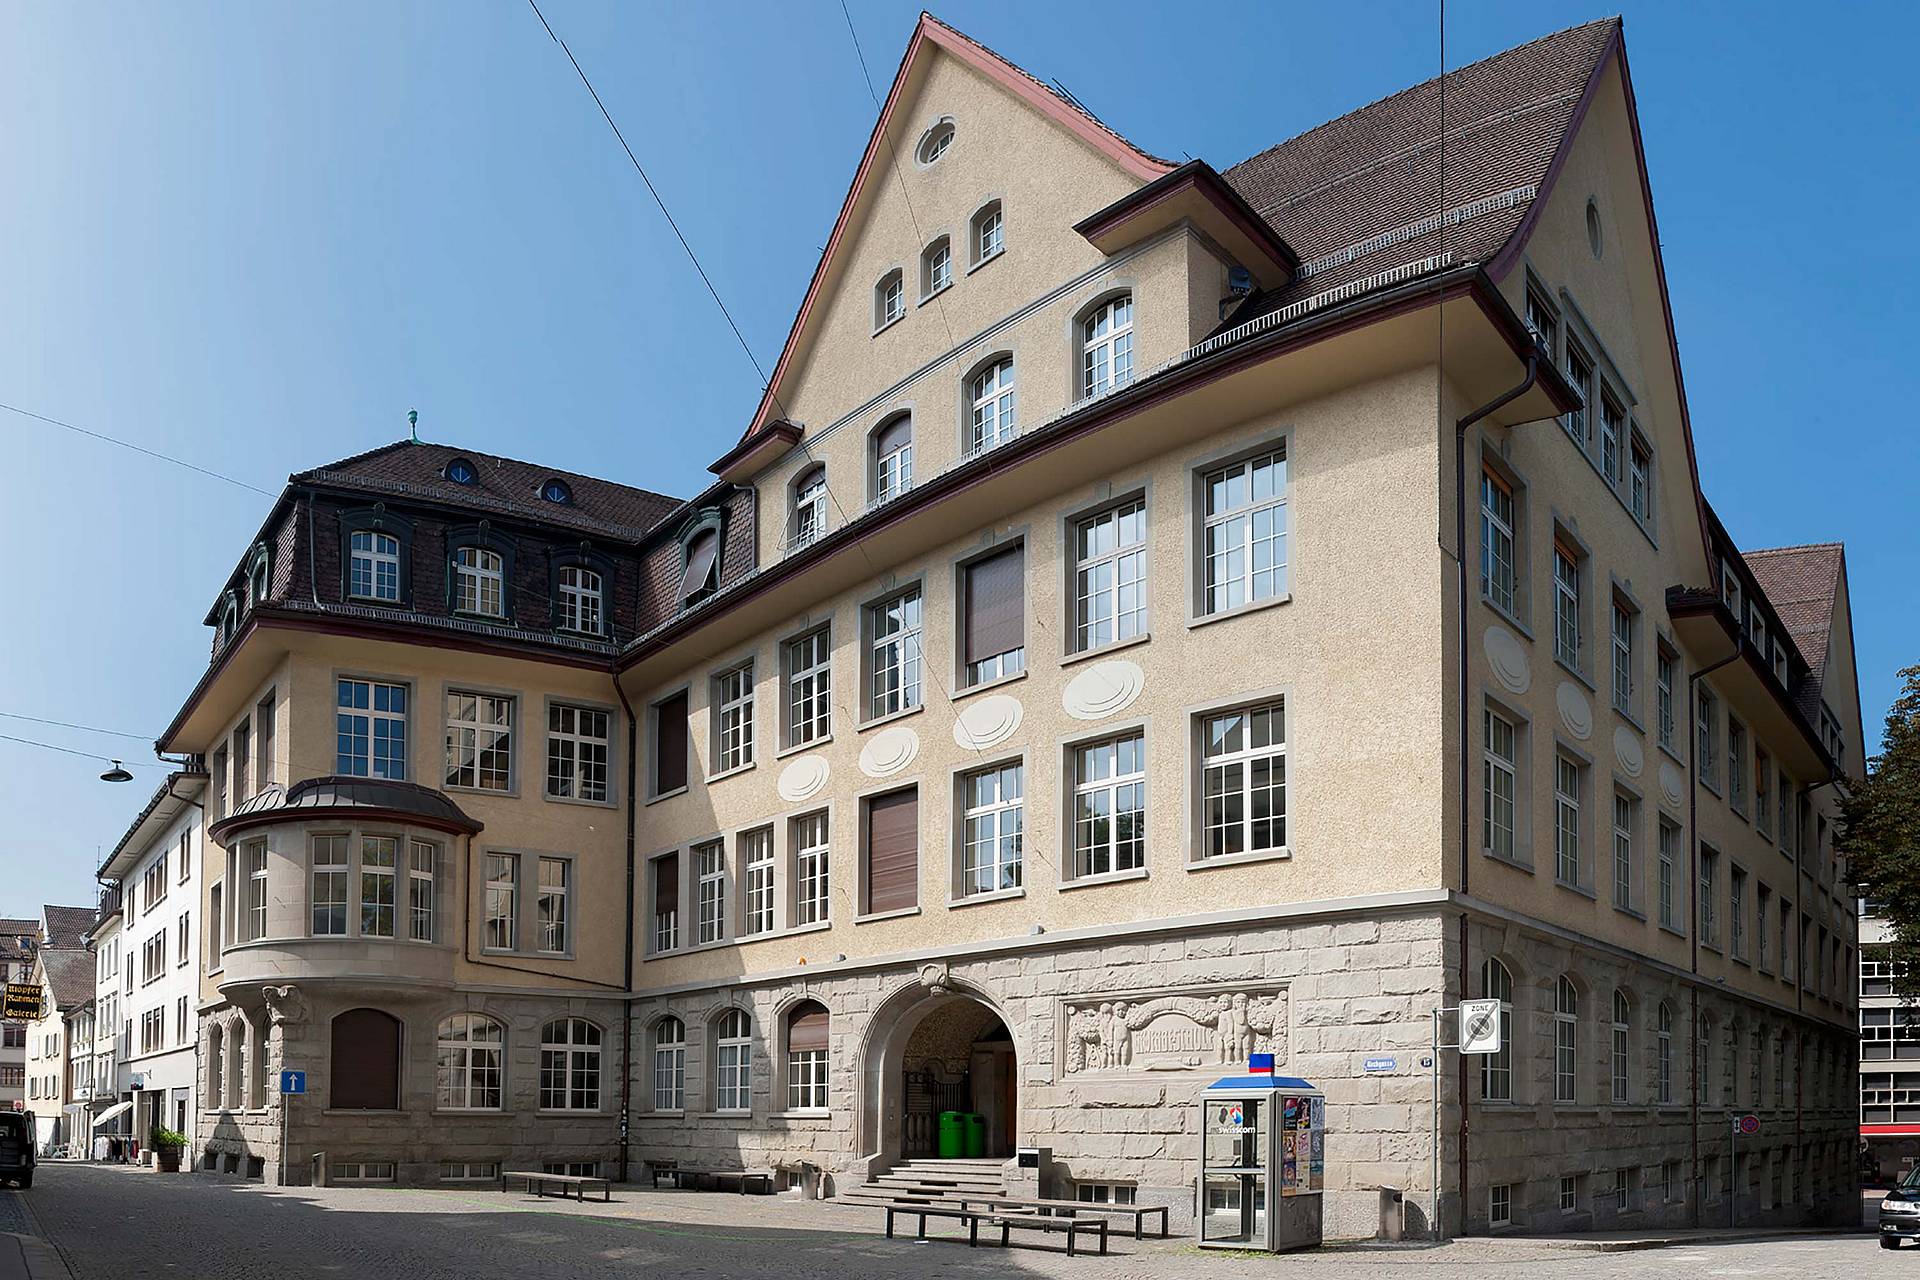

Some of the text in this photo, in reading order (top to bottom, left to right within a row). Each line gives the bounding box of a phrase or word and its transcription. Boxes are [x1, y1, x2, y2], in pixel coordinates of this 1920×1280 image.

[1471, 1004, 1489, 1012] ZONE
[5, 1008, 38, 1018] Galerie
[1217, 1125, 1256, 1134] swisscom
